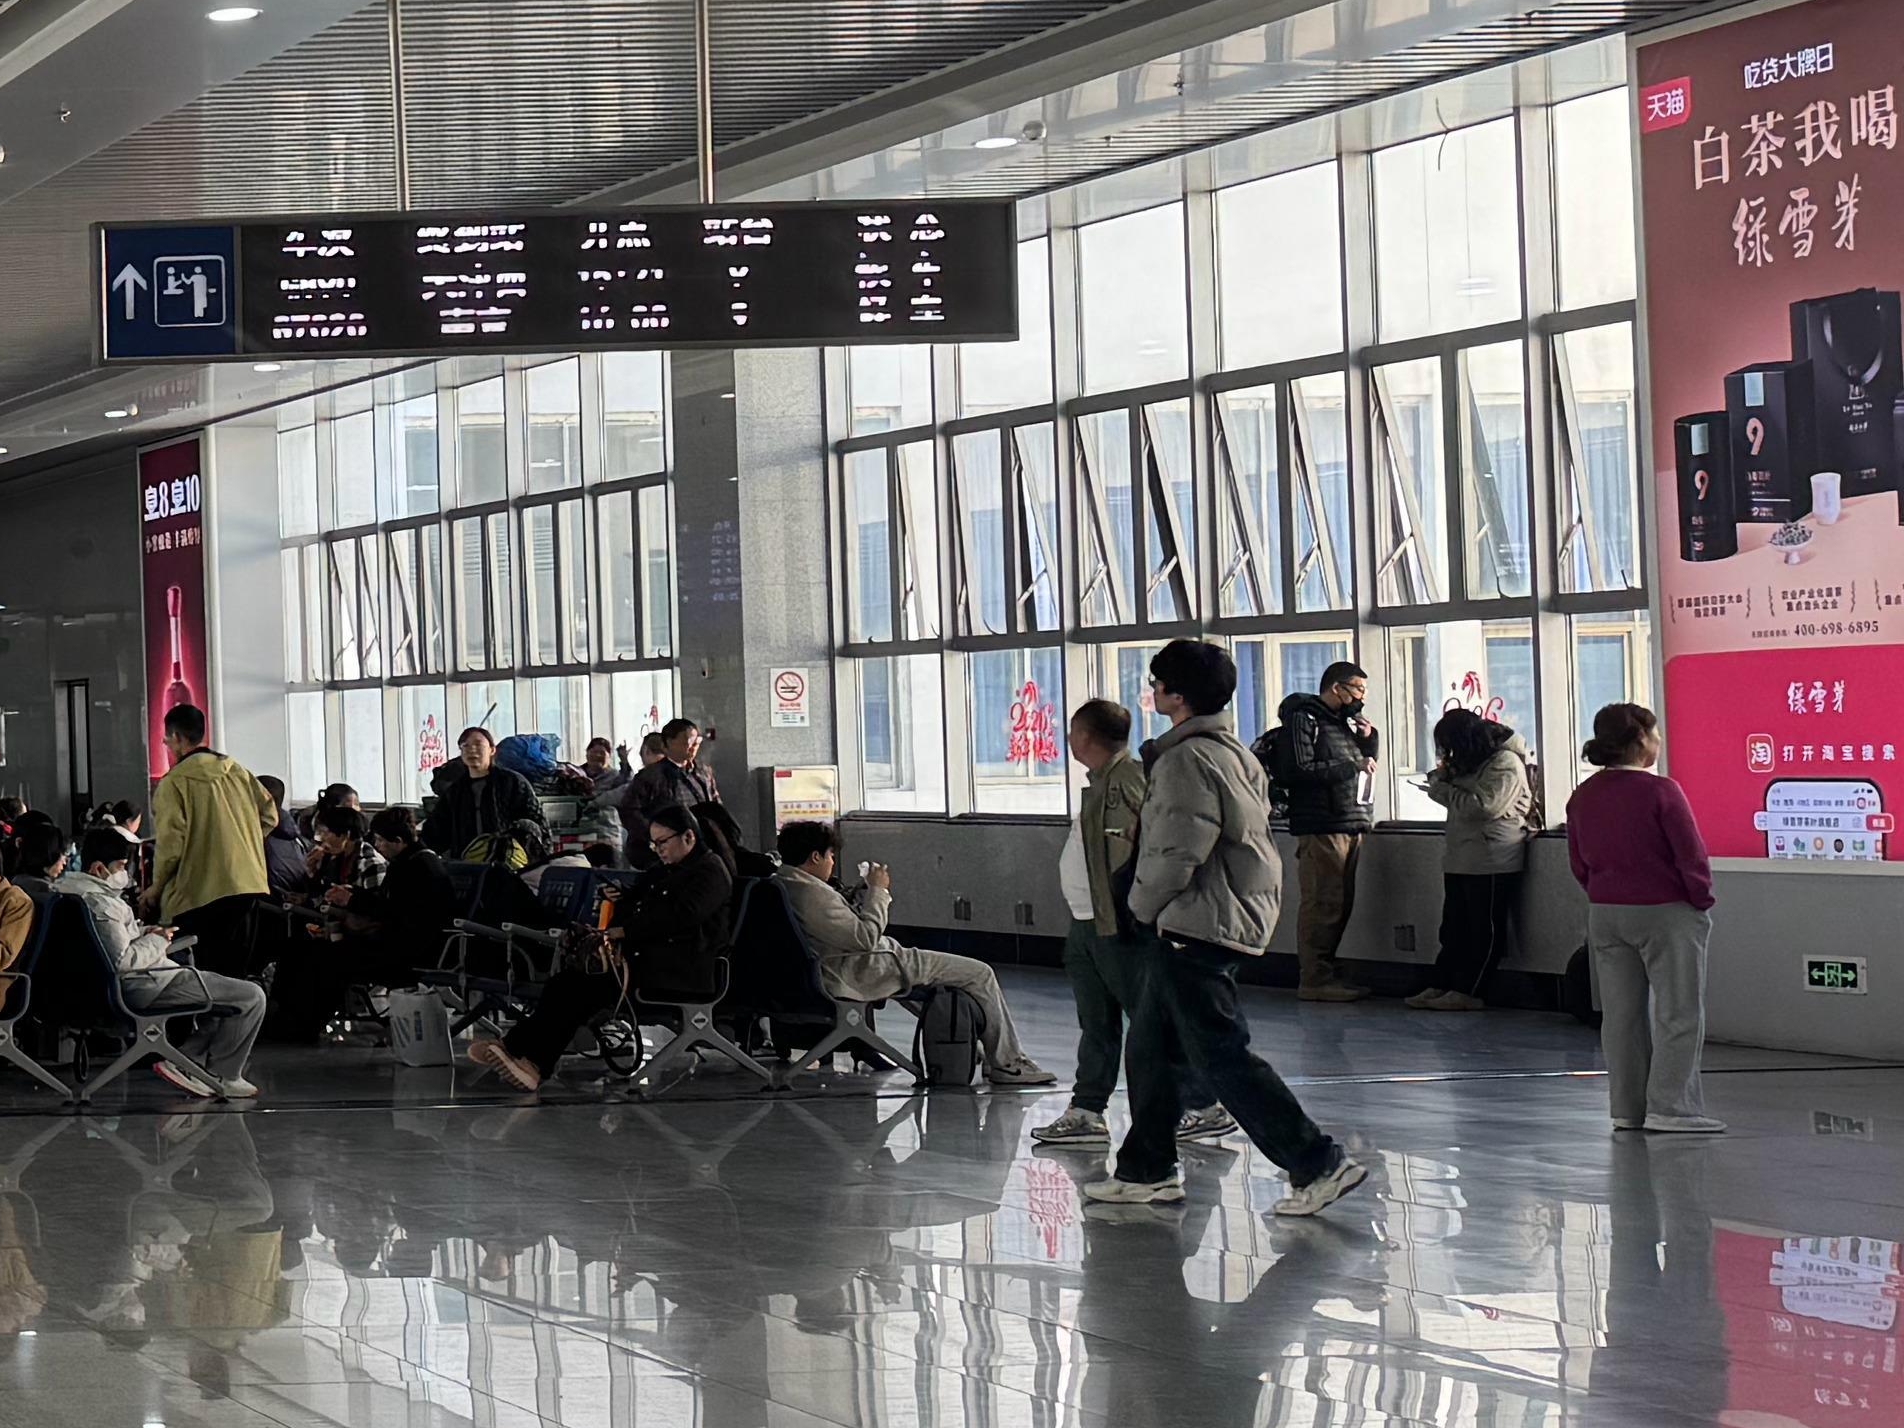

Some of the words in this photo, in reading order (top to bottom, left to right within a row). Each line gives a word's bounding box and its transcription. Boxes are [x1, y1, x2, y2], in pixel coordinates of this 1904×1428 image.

[1744, 42, 1834, 89] 吃货大牌日
[1647, 88, 1685, 121] 天猫
[1693, 83, 1898, 190] 白茶我喝
[1745, 417, 1765, 456] 9
[1694, 469, 1710, 500] 9
[1794, 620, 1879, 636] 400-698-6895
[1751, 742, 1772, 765] 淘
[1782, 744, 1896, 762] 打开淘宝搜索
